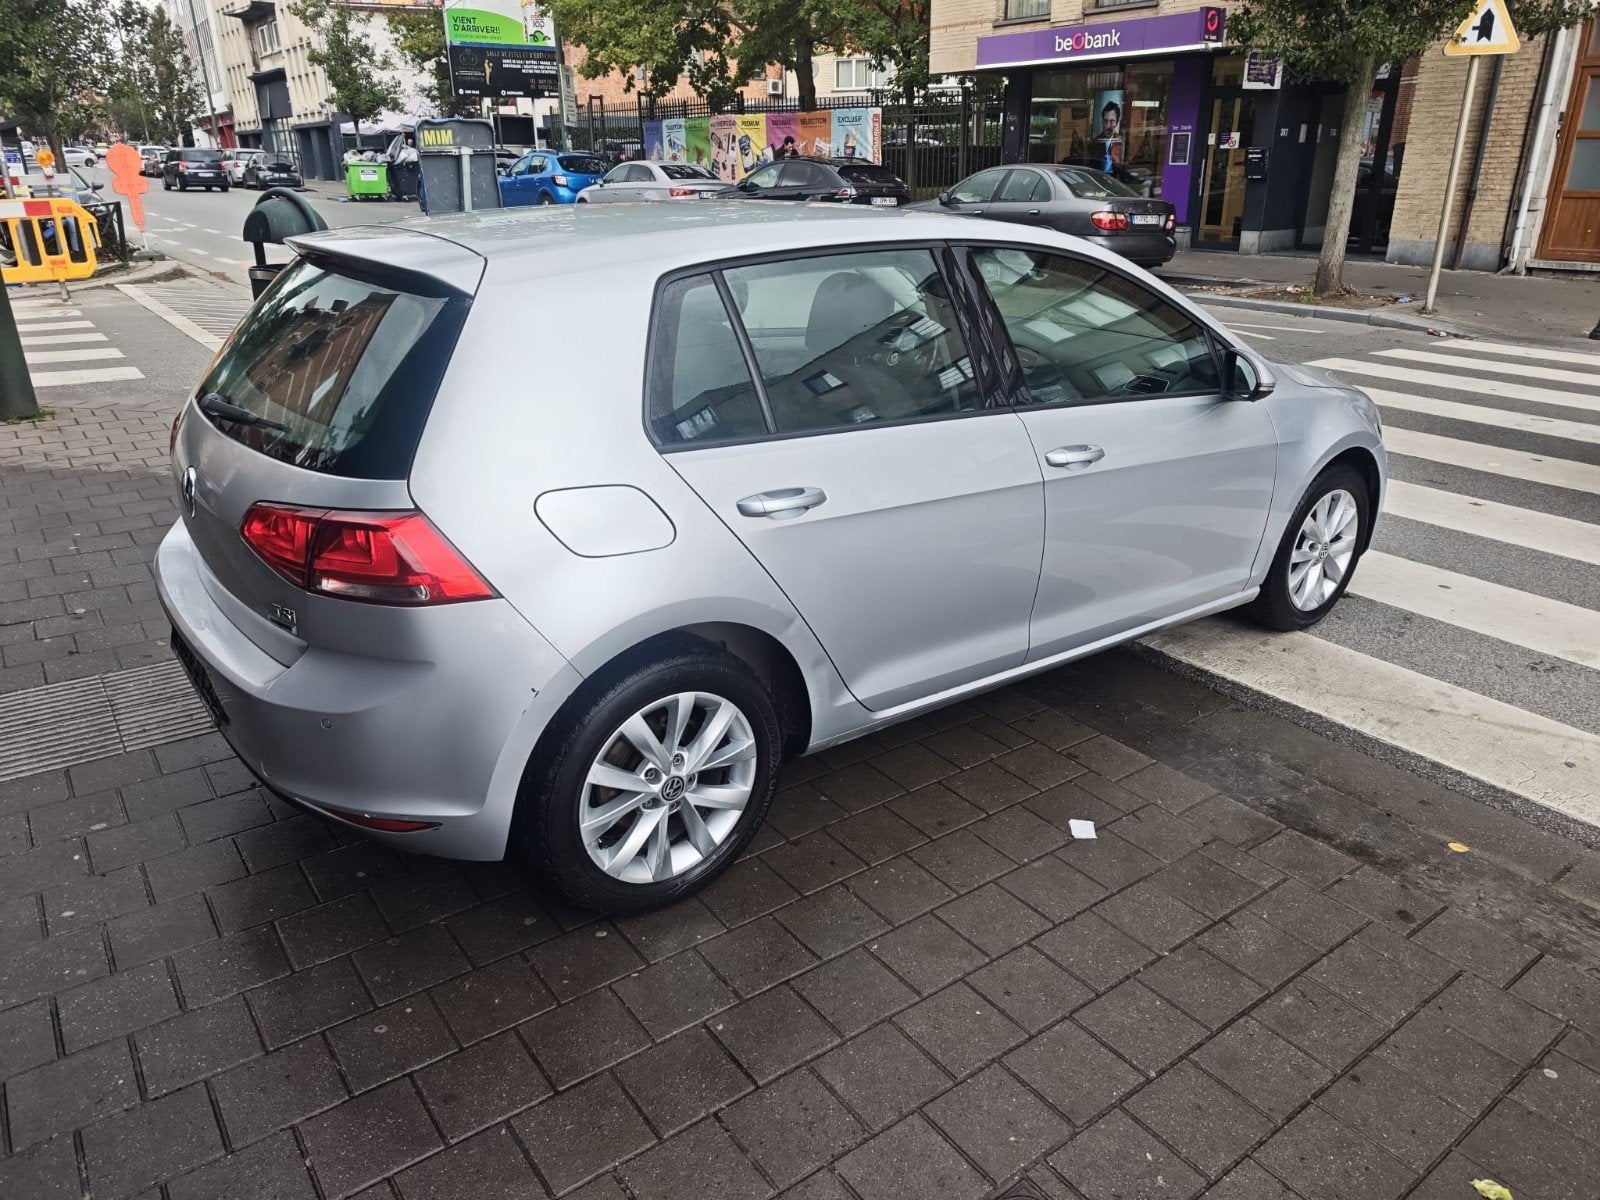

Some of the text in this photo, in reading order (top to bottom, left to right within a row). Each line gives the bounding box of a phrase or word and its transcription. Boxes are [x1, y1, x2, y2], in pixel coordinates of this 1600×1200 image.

[452, 15, 477, 25] VIENT
[453, 24, 501, 34] D'ARRIVER!!
[837, 115, 863, 124] EXCLUSIF
[423, 129, 453, 146] MIM
